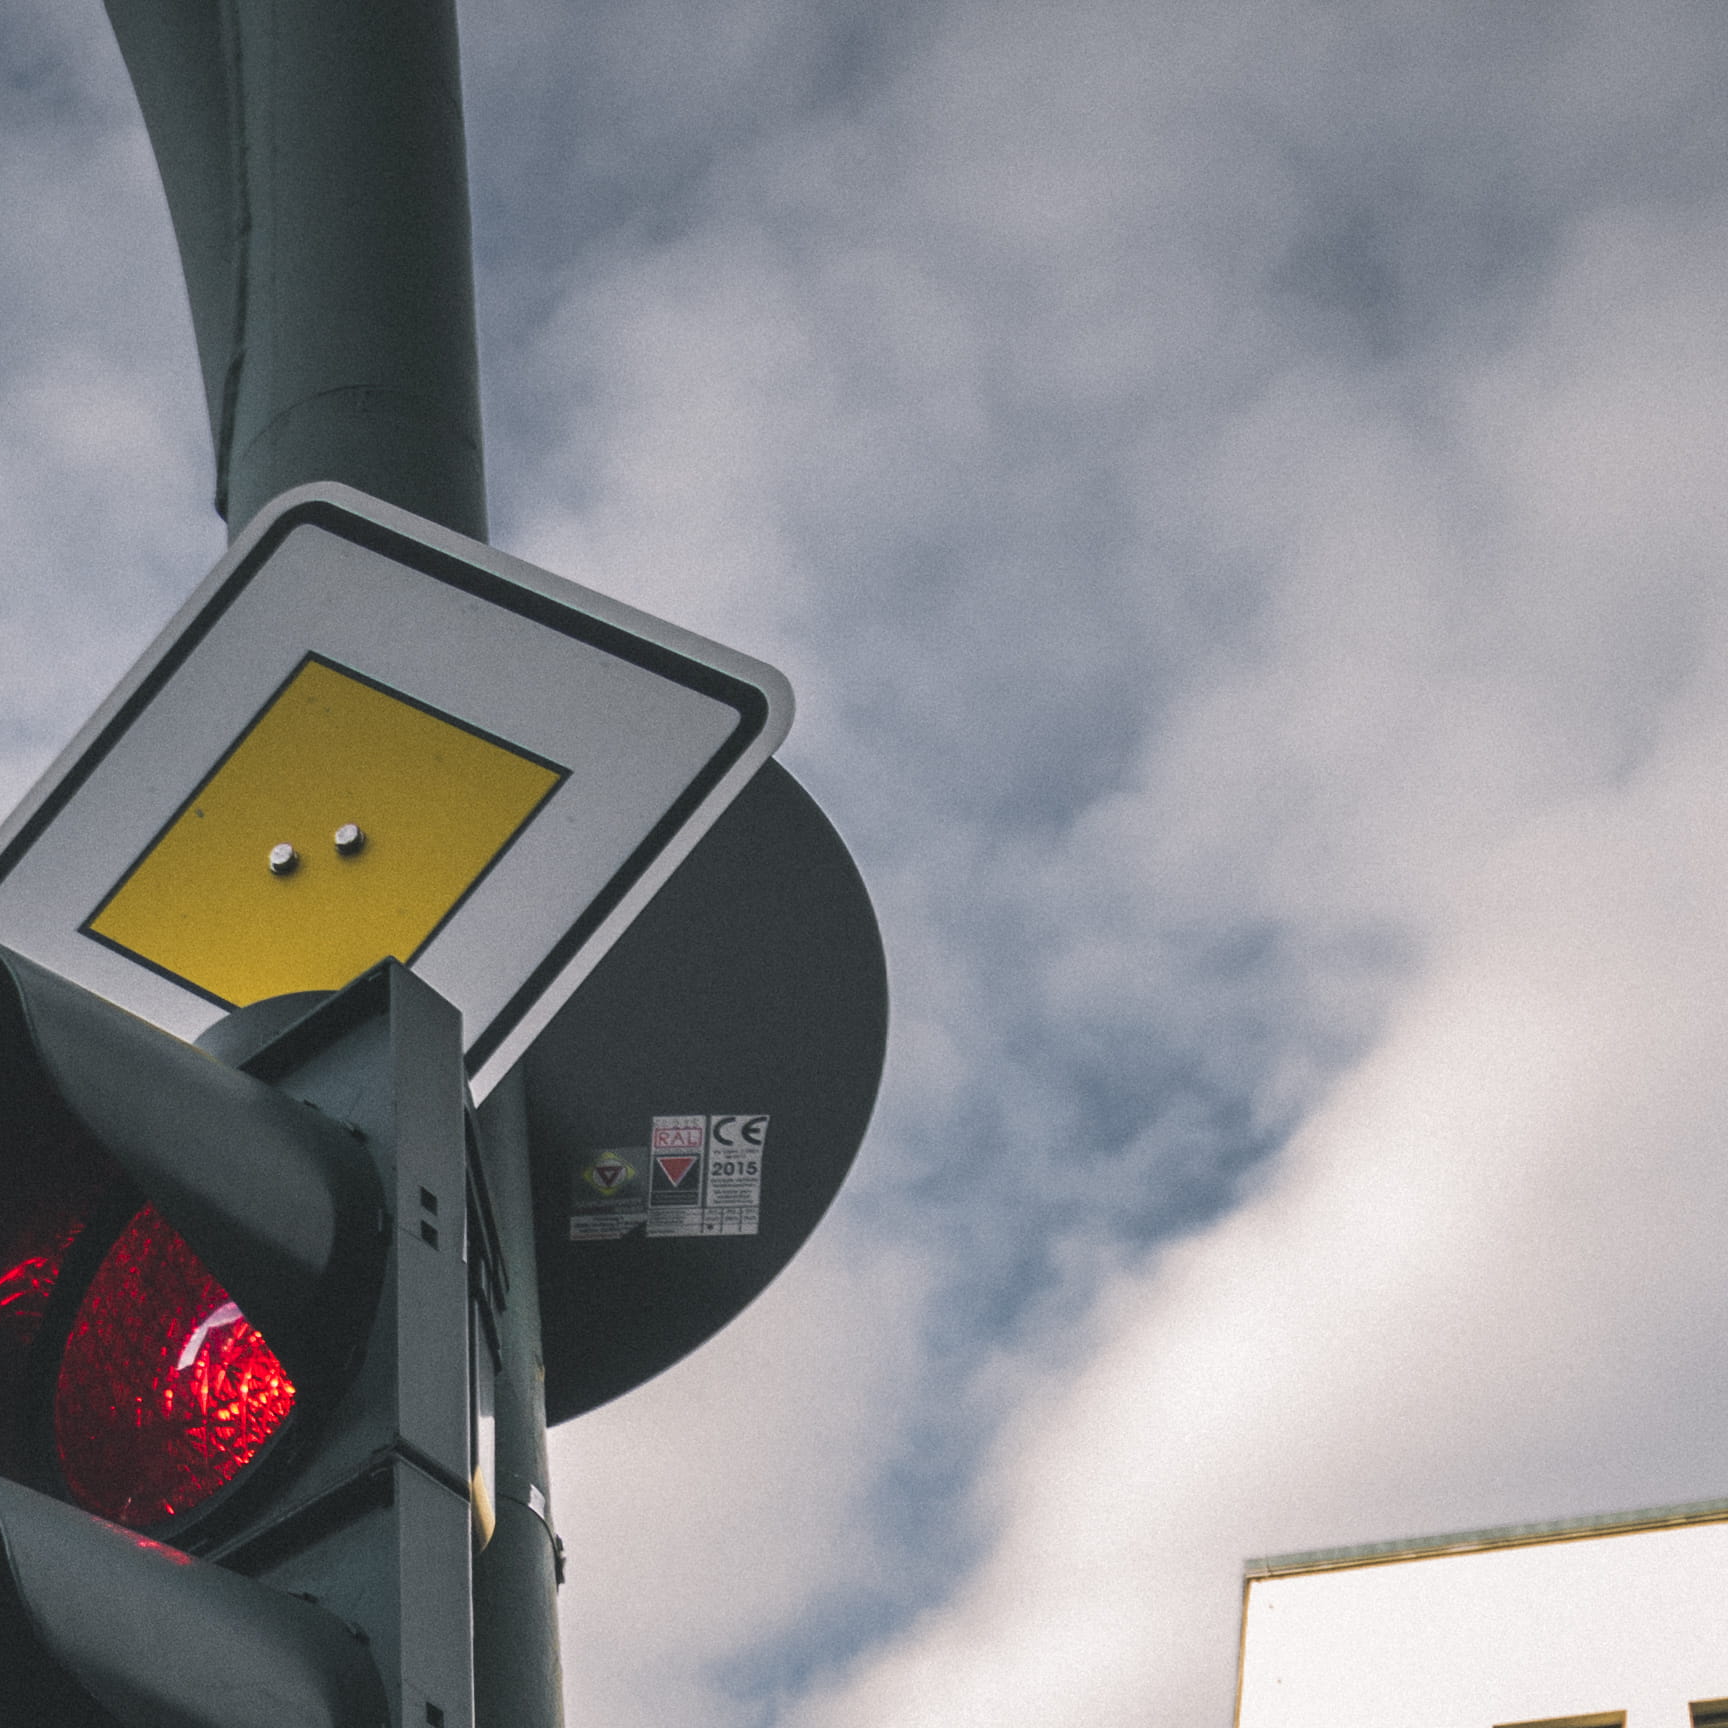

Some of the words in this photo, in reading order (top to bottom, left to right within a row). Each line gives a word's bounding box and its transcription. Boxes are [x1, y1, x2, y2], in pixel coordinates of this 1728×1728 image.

[657, 1131, 699, 1146] RAL
[713, 1116, 767, 1147] CE
[711, 1161, 759, 1177] 2015
